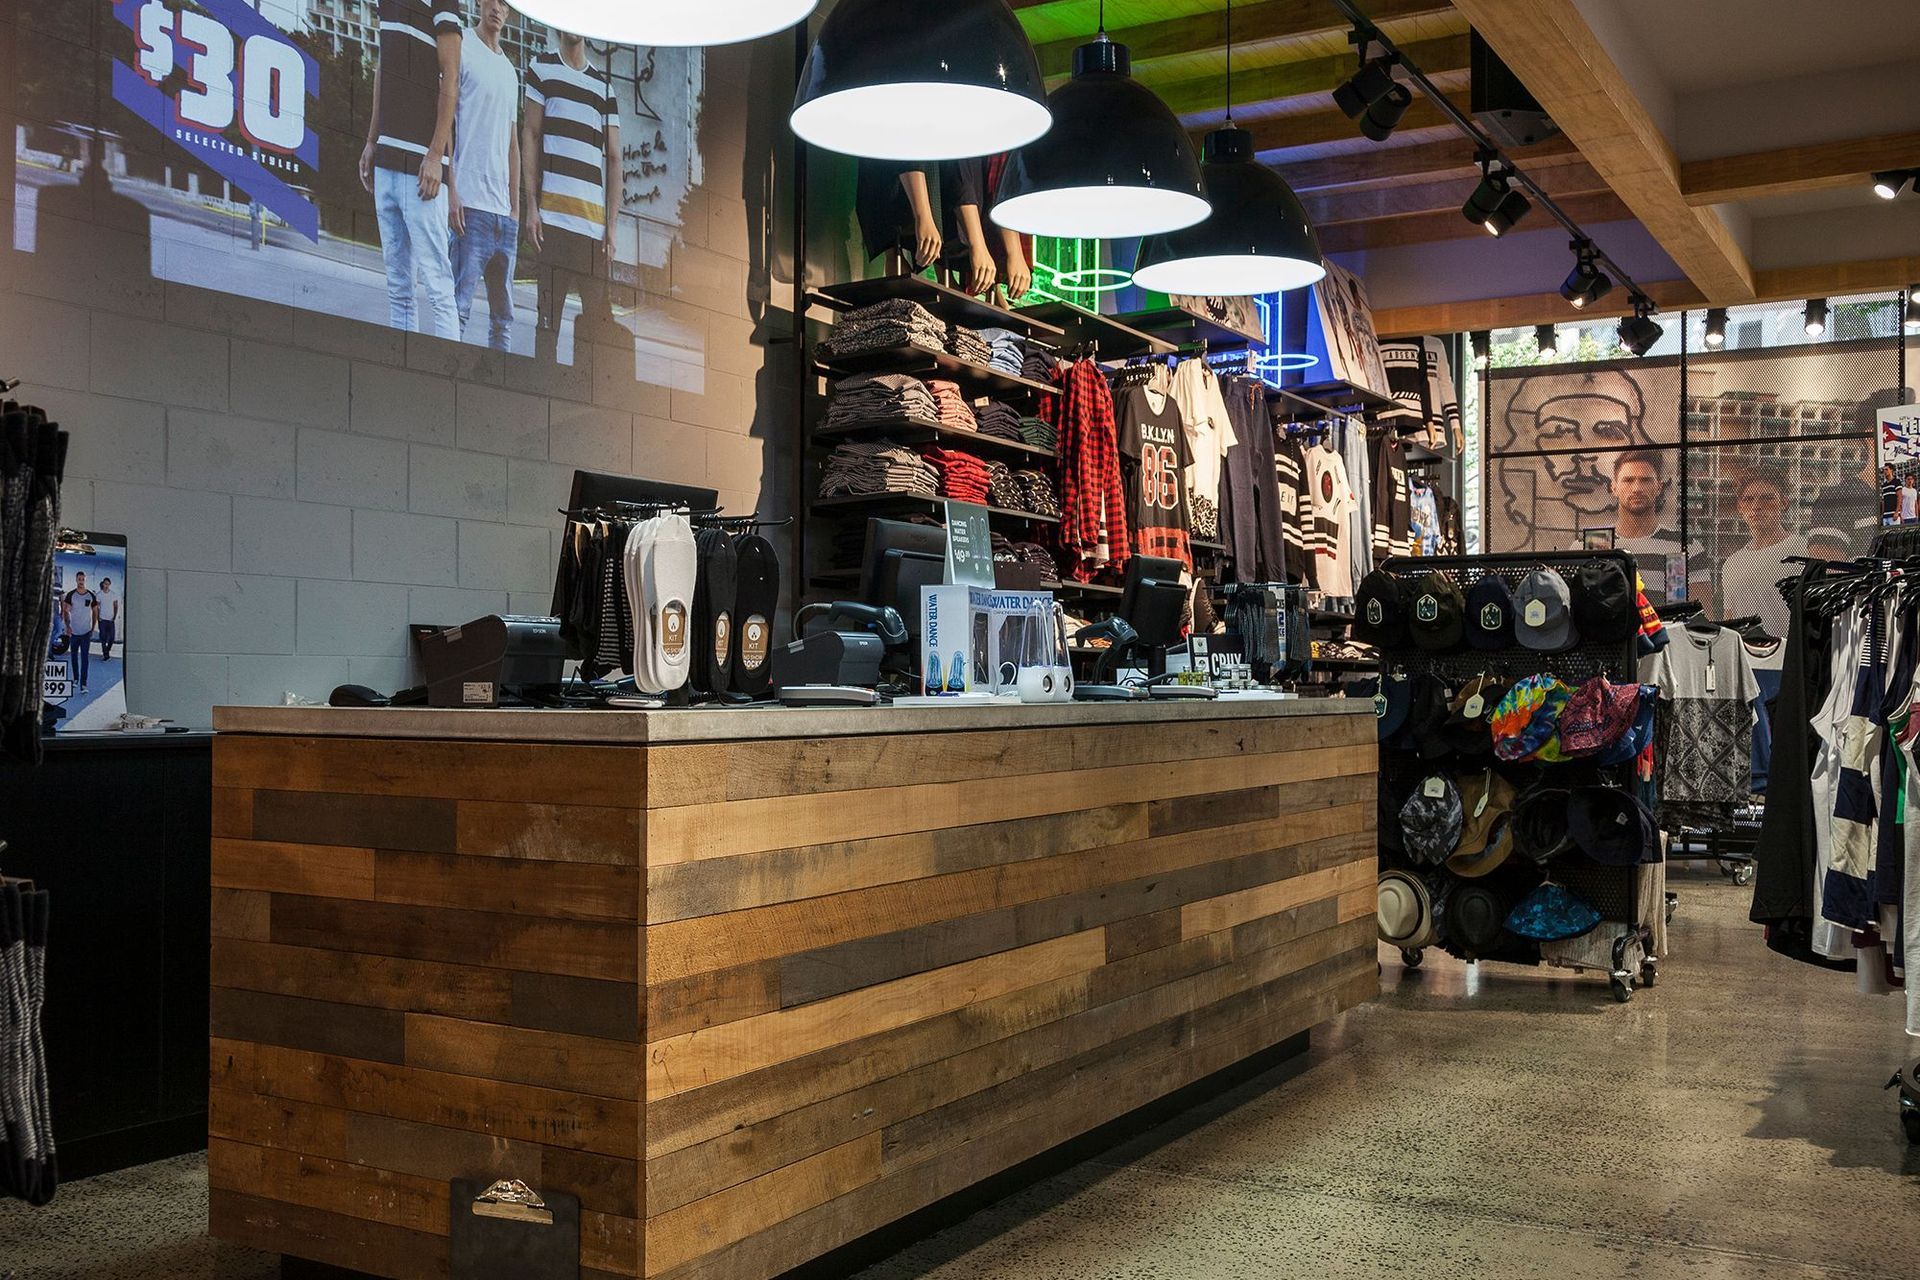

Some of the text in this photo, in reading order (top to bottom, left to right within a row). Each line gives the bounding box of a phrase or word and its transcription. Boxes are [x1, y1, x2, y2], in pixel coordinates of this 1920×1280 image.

[137, 0, 305, 151] $30
[176, 129, 300, 174] SELECTED STYLES
[1141, 442, 1179, 510] 86
[929, 594, 937, 648] WATER DANCE
[991, 596, 1021, 609] WATER
[45, 681, 65, 694] $99
